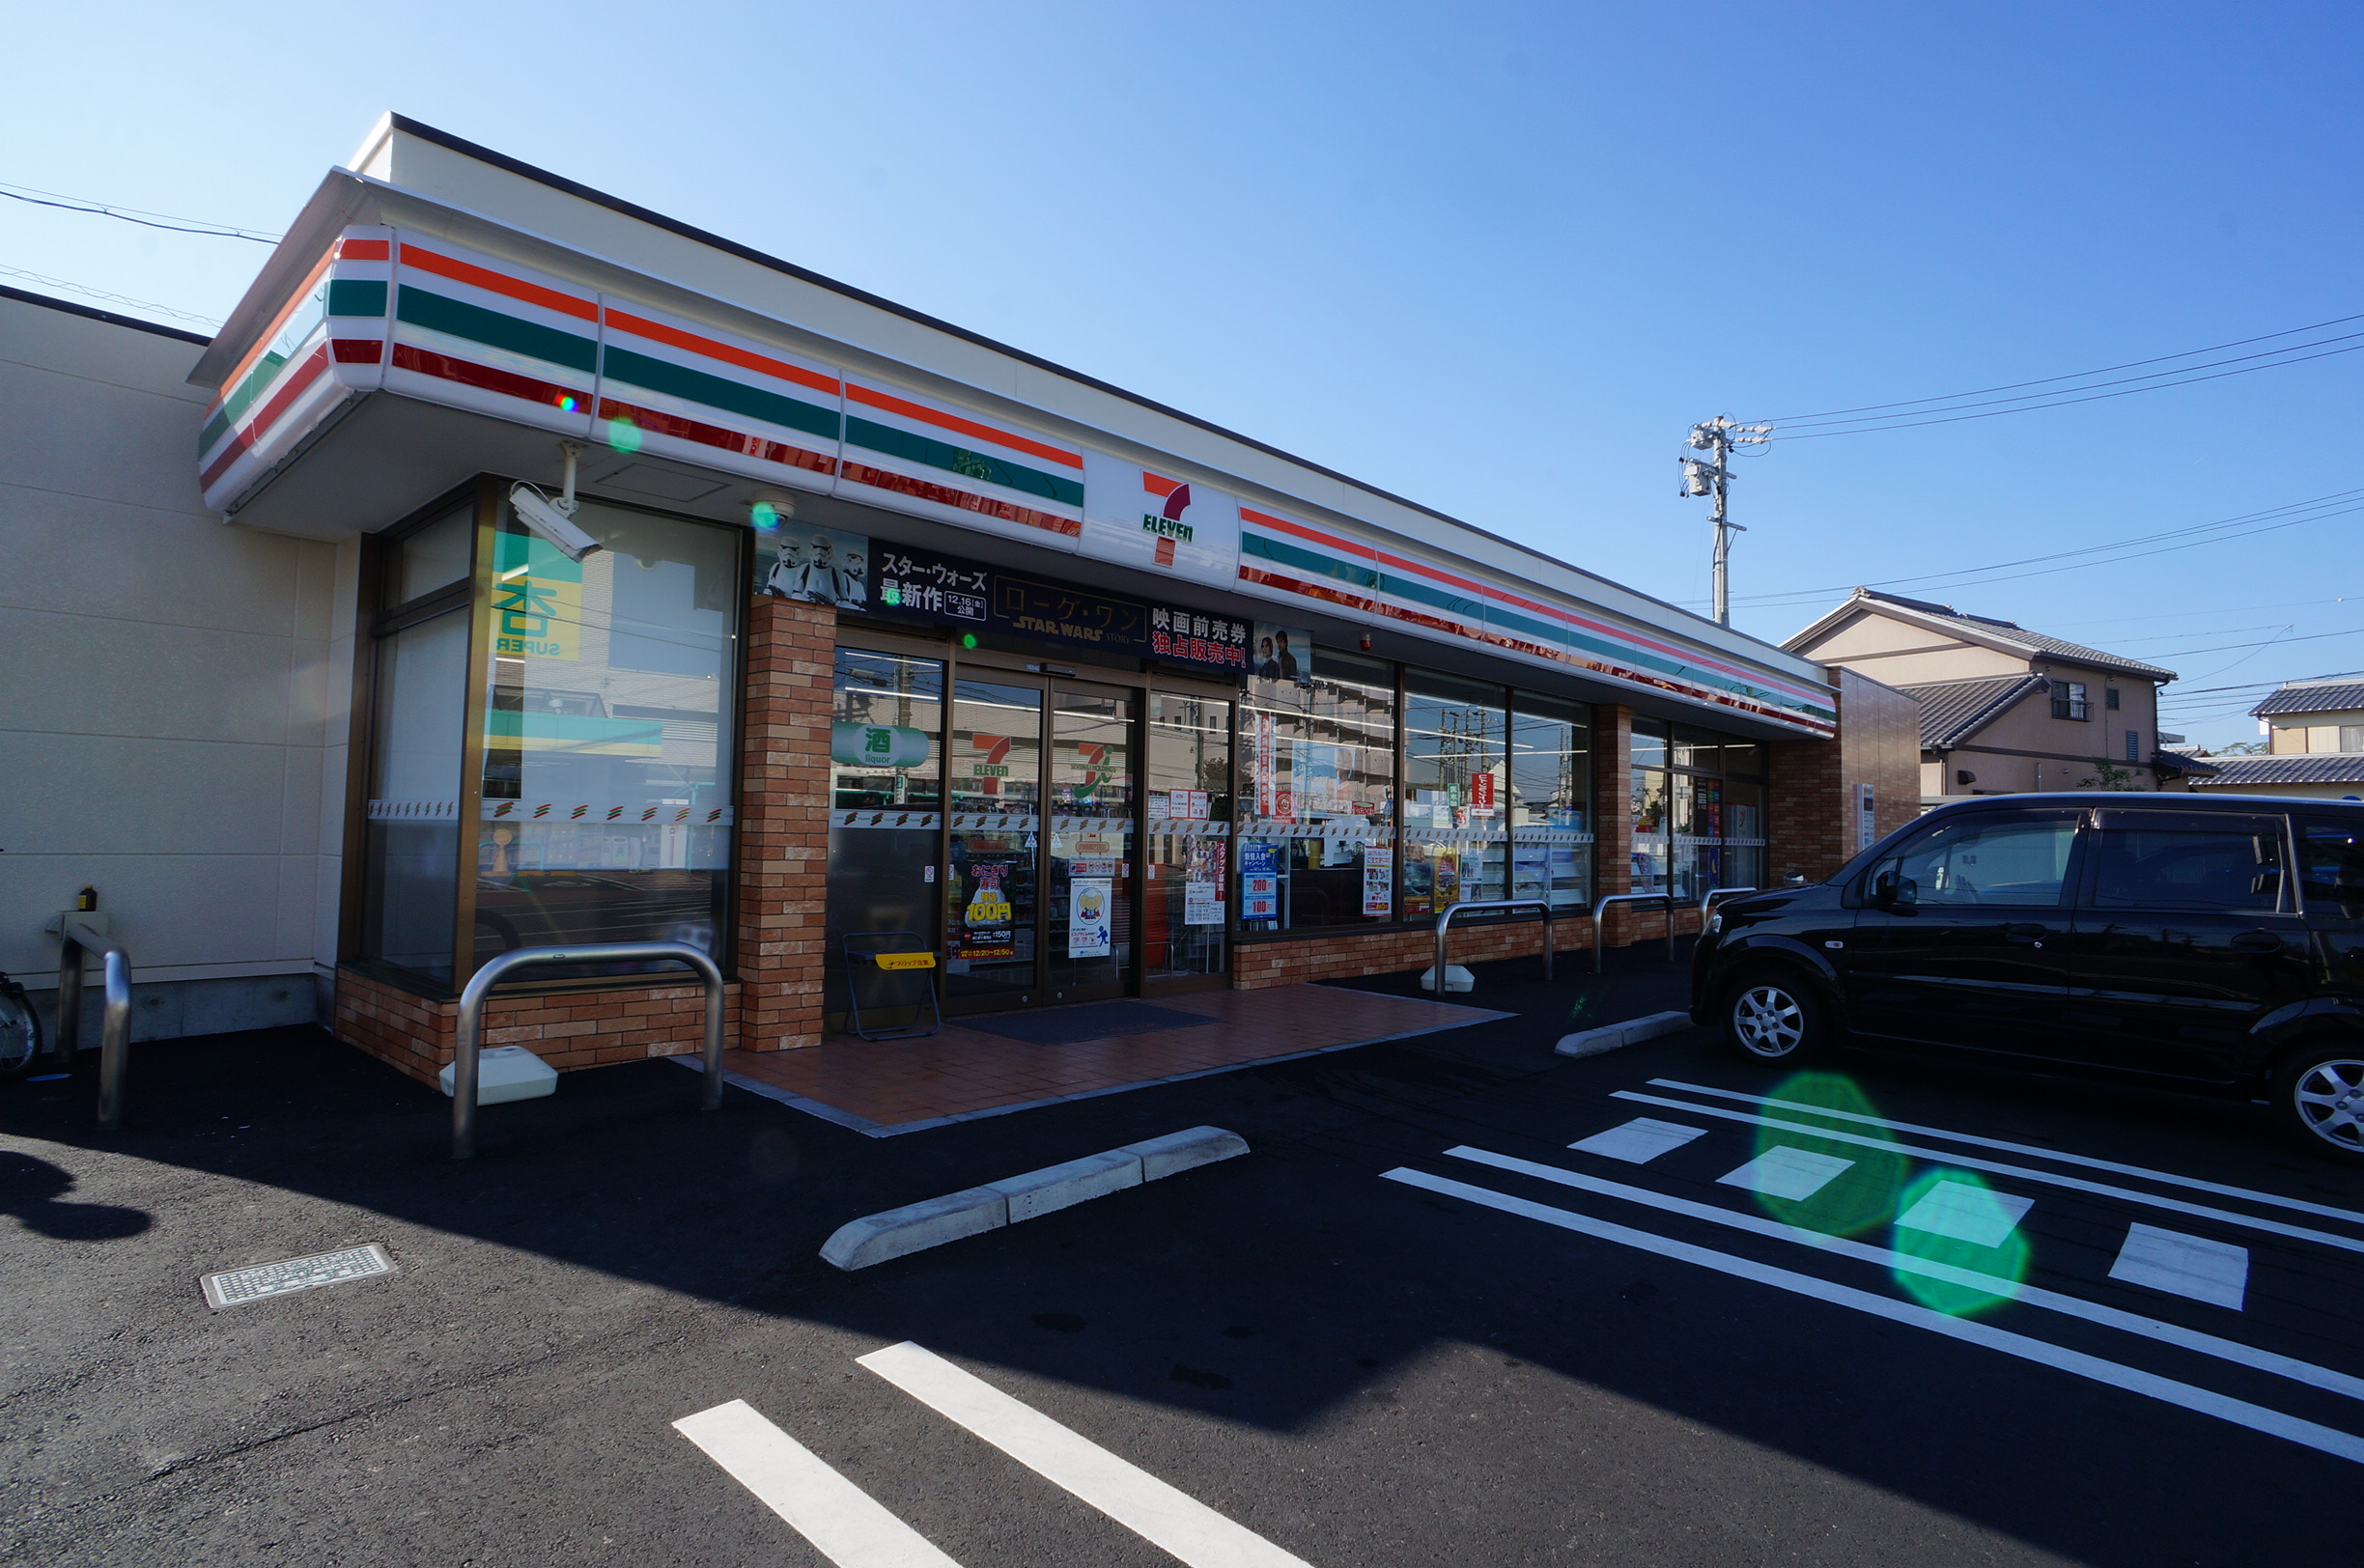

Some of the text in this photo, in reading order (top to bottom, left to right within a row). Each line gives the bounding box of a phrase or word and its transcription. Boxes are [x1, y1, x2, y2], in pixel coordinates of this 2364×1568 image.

[1141, 513, 1194, 544] ELEVEN
[881, 552, 988, 592] スター・ウォーズ
[880, 577, 943, 612] 最新作
[1006, 586, 1137, 630] ローグ・ワン
[1013, 615, 1059, 635] STAR
[1059, 622, 1103, 642] WARS
[1152, 607, 1247, 644] 映画前売券
[1152, 630, 1247, 668] 独占販売中!
[864, 727, 891, 753] 酒
[865, 754, 891, 764] liquor
[973, 764, 1009, 777] ELEVEN
[971, 864, 1008, 878] おにぎり
[979, 877, 1000, 889] 寿司
[1252, 880, 1267, 891] 200
[967, 902, 1012, 921] 100円
[1252, 901, 1267, 912] 100
